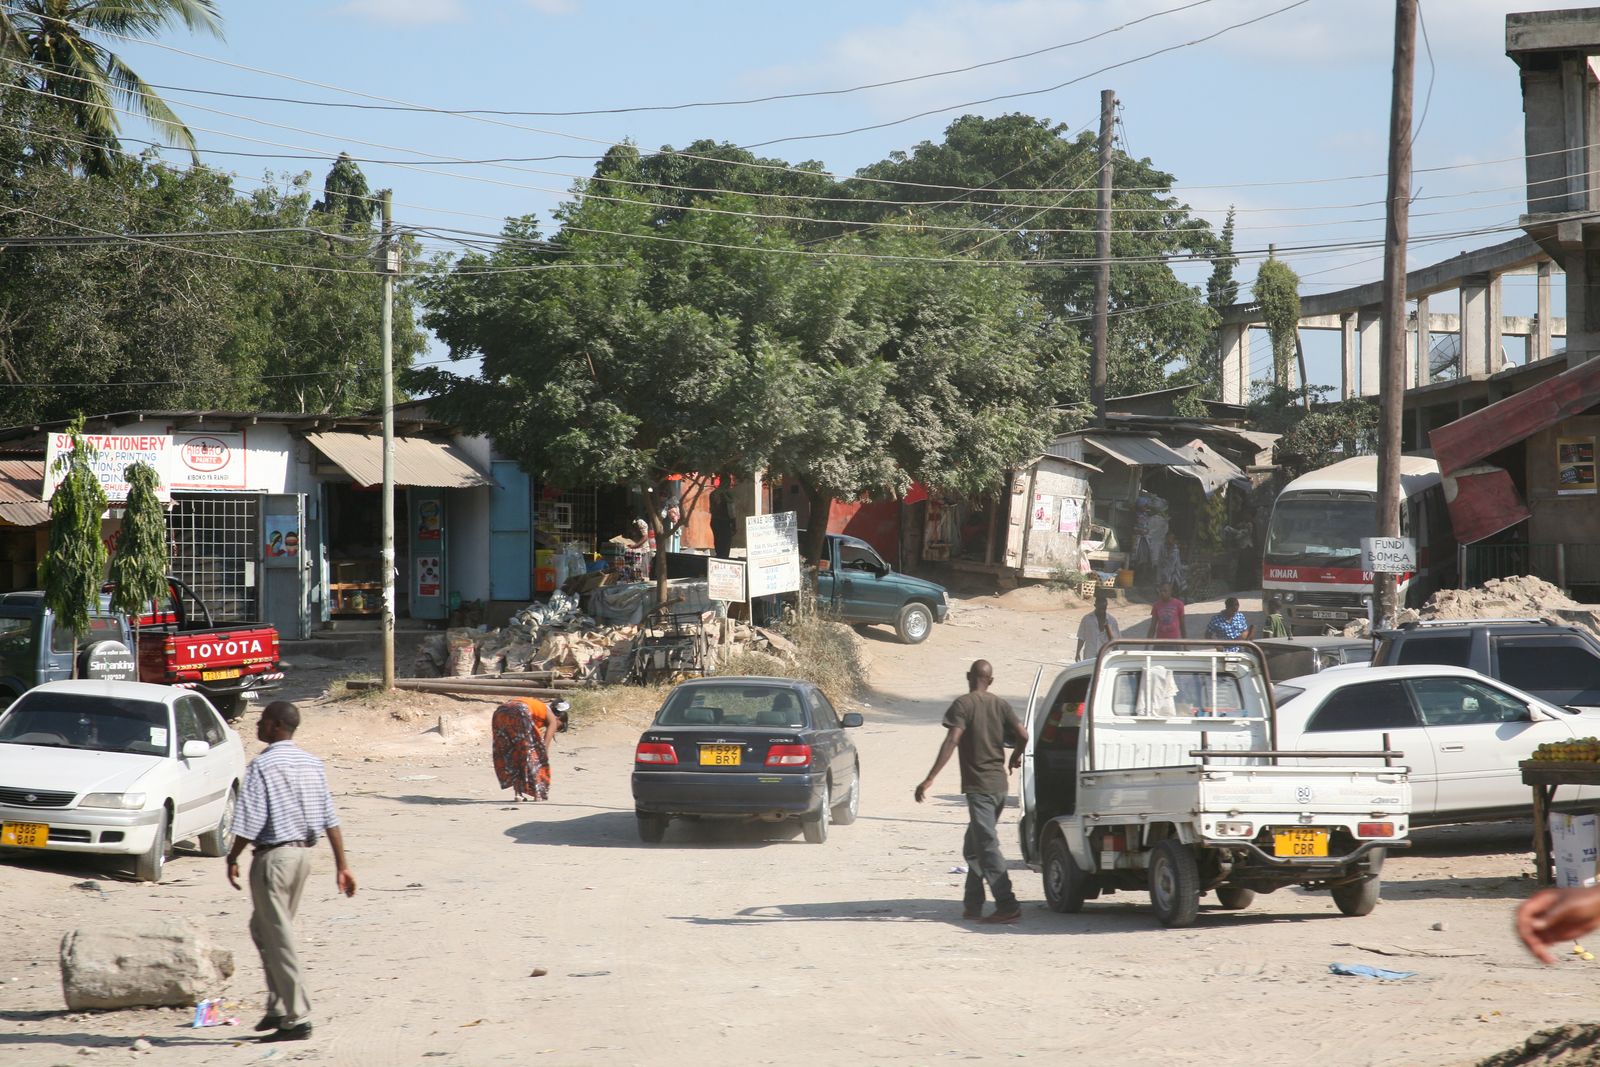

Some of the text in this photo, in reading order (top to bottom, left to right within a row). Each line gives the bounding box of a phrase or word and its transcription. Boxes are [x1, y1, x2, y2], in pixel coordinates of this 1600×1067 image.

[87, 436, 166, 451] STATIONERY
[115, 451, 157, 461] PRINTING
[1375, 539, 1404, 550] FUNDI
[1367, 551, 1410, 562] BOMBA
[1269, 568, 1298, 579] KIMARA
[187, 640, 262, 659] TOYOTA
[715, 755, 737, 764] BRY
[1297, 787, 1311, 797] 80
[1293, 843, 1315, 855] CBR
